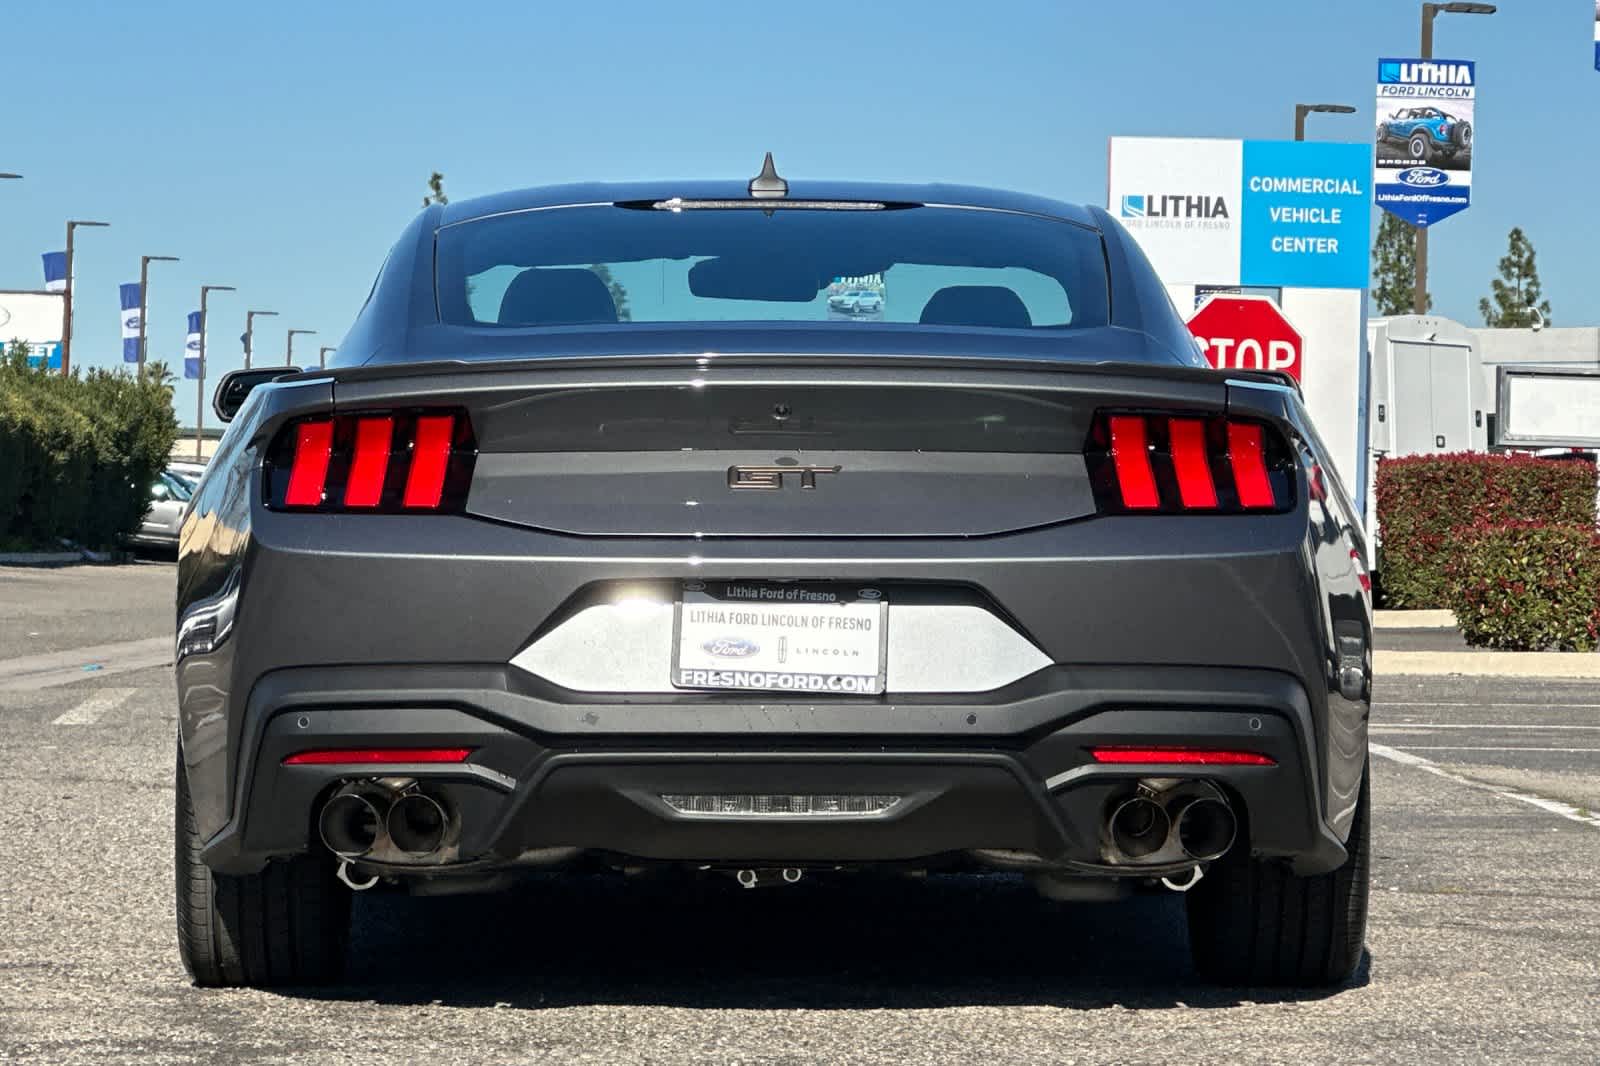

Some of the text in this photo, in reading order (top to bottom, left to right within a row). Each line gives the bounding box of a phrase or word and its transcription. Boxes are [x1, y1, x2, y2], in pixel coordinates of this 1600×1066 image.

[1400, 62, 1472, 84] LITHIA
[1381, 86, 1470, 97] FORD LINCOLN
[1250, 176, 1362, 195] COMMERCIAL
[1147, 194, 1229, 218] LITHIA
[1270, 207, 1341, 224] VEHICLE
[1271, 237, 1339, 254] CENTER
[727, 464, 843, 490] GT
[726, 586, 836, 602] Lithia Ford of Fresno
[690, 610, 872, 632] LITHIA FORD LINCOLN OF FRESNO
[796, 647, 860, 657] LINCOLN
[681, 670, 876, 692] FRESNOFORD.COM
